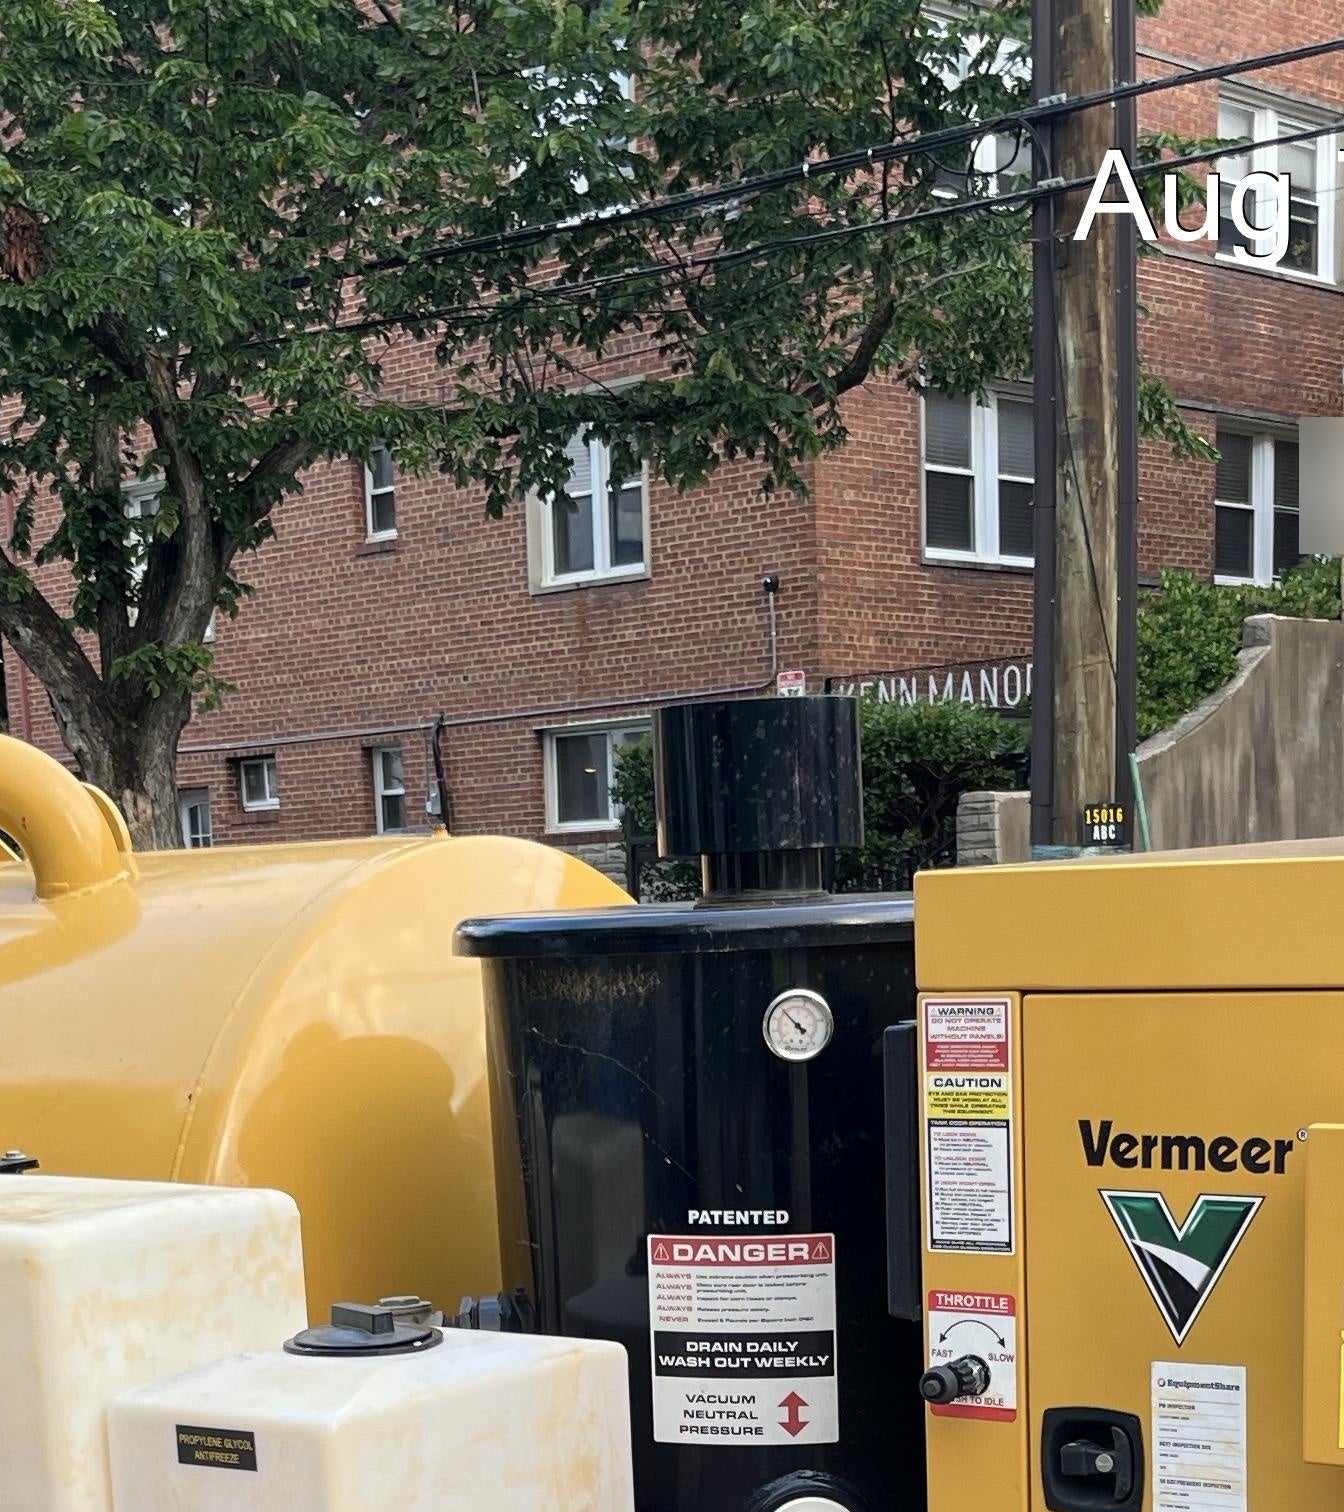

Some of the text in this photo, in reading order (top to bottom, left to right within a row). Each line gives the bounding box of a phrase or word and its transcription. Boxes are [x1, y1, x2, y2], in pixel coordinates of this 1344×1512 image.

[928, 664, 1033, 706] MANO
[1085, 807, 1124, 825] 15016
[1092, 824, 1116, 841] ABC
[937, 1007, 995, 1015] WARNING
[934, 1078, 1002, 1088] CAUTION
[1078, 1119, 1294, 1175] Vermeer
[687, 1209, 790, 1225] PATENTED
[672, 1243, 810, 1263] DANGER
[935, 1293, 1009, 1310] THROTTLE
[686, 1341, 799, 1353] DRAIN DAILY
[931, 1348, 954, 1358] FAST
[658, 1355, 829, 1368] WASH OUT WEEKLY
[988, 1352, 1015, 1363] SLOW
[1167, 1379, 1240, 1391] EquipmentShare
[685, 1394, 756, 1405] VACUUM
[969, 1395, 982, 1404] TO
[984, 1397, 1004, 1407] IDLE
[683, 1410, 759, 1420] NEUTRAL
[679, 1425, 764, 1436] PRESSURE
[178, 1434, 254, 1451] PROPYLENE GLYCOL
[194, 1451, 241, 1465] ANTIFREEZE
